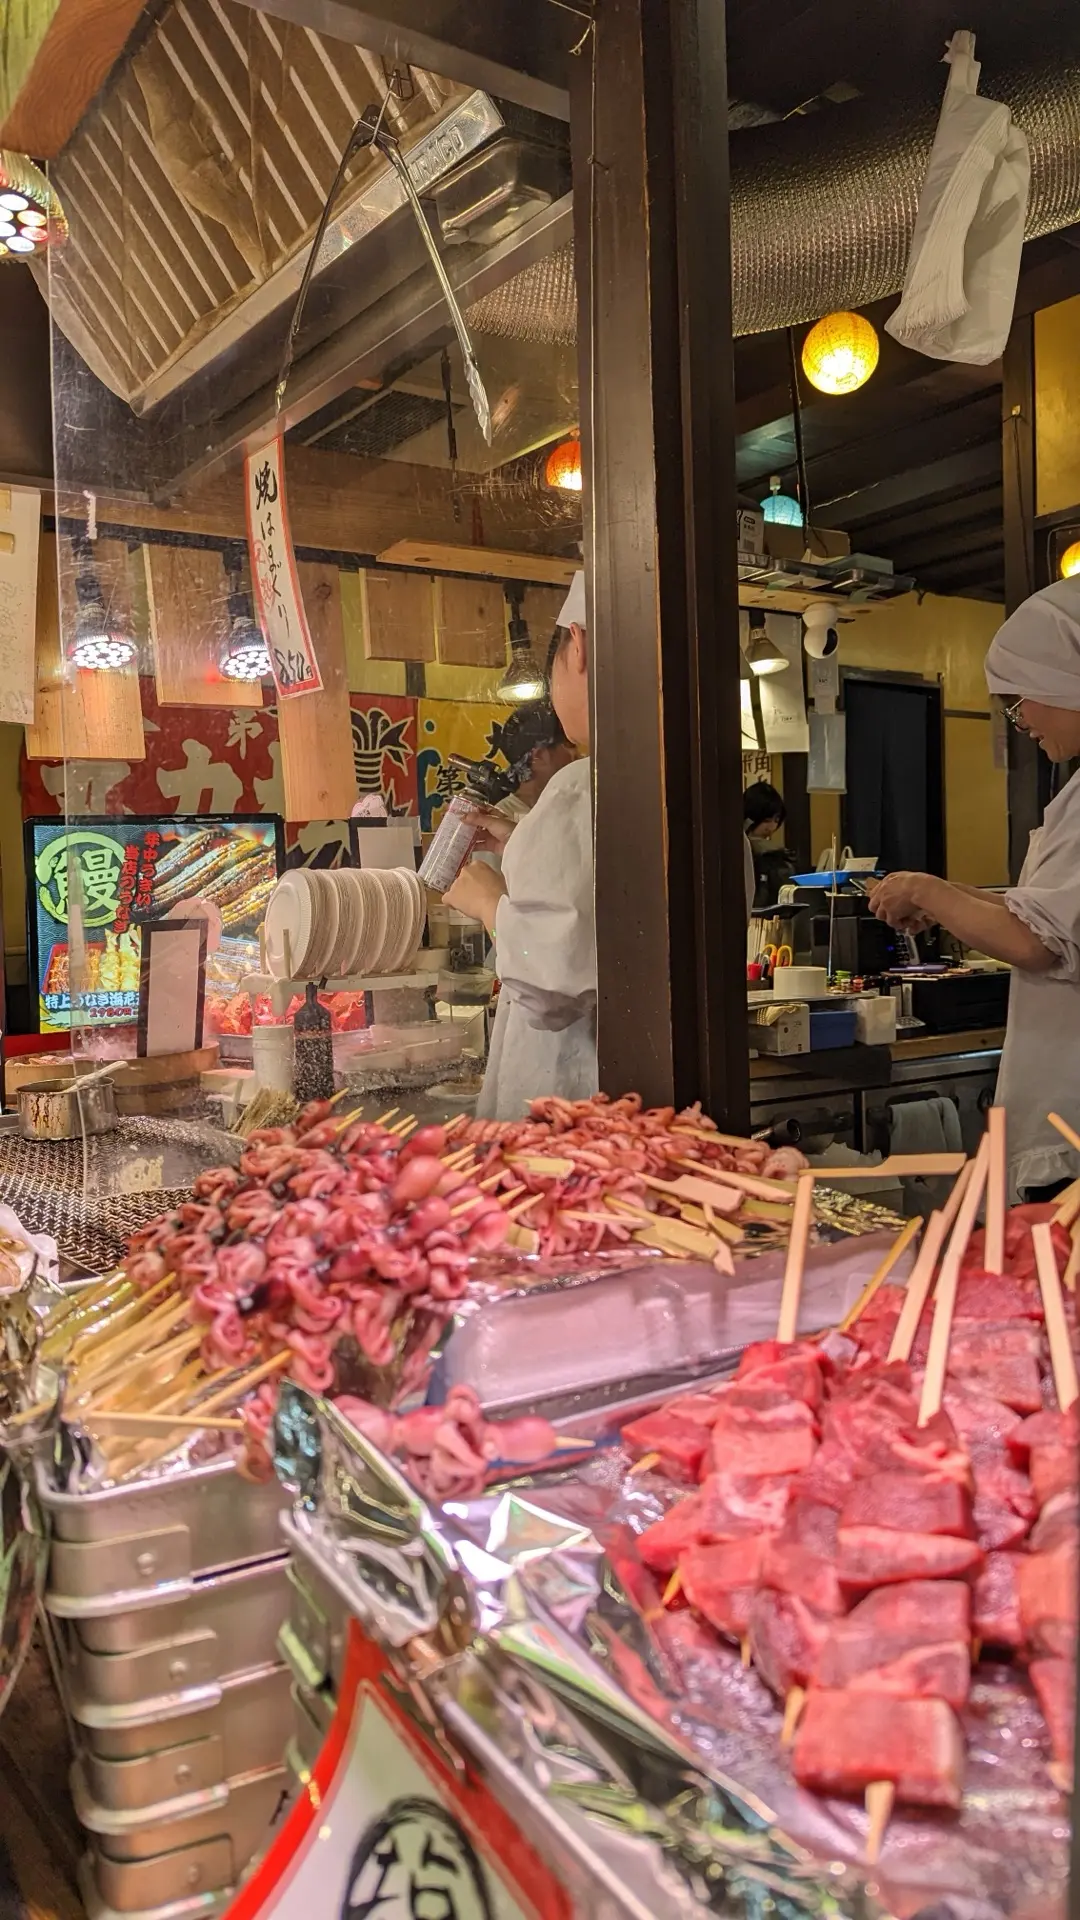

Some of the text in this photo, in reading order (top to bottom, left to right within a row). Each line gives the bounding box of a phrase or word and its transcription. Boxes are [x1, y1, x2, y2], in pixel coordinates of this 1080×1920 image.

[254, 460, 288, 638] 焼はまぐり
[135, 831, 161, 906] 年中うまい
